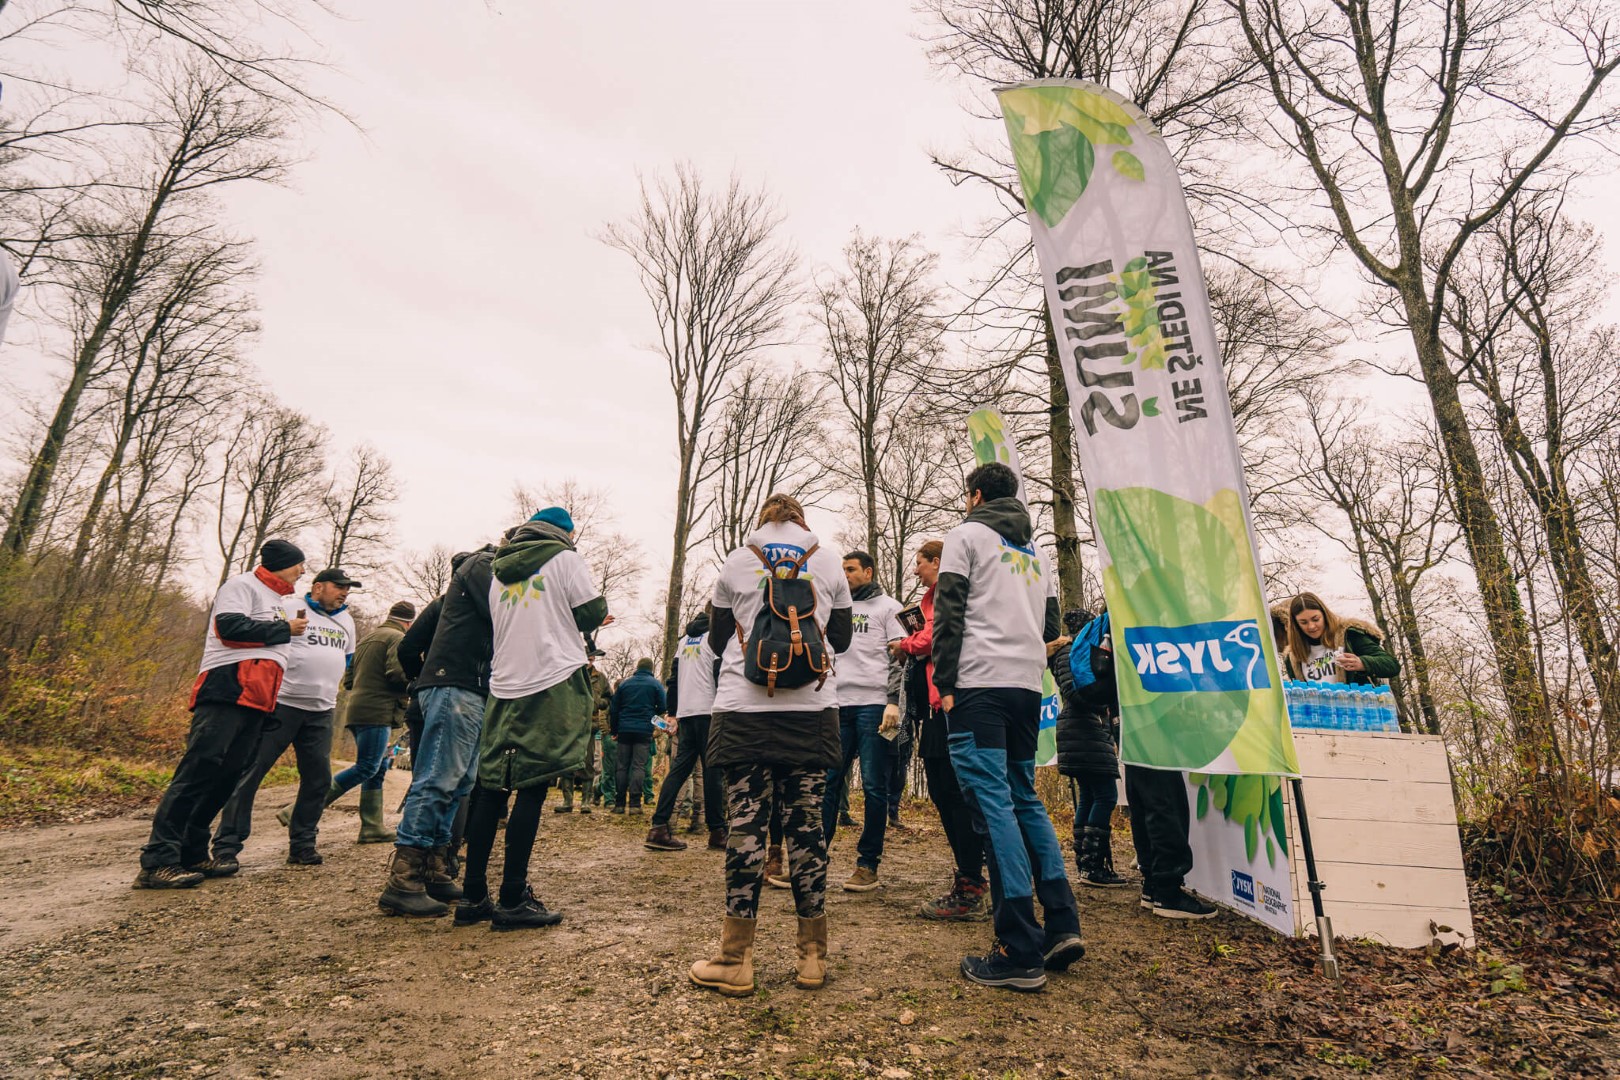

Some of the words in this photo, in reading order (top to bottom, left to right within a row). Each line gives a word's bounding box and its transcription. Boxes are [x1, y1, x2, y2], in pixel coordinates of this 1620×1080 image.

[307, 631, 346, 650] ŠUMI
[1236, 877, 1253, 896] JYSK
[1262, 885, 1282, 901] NATIONAL
